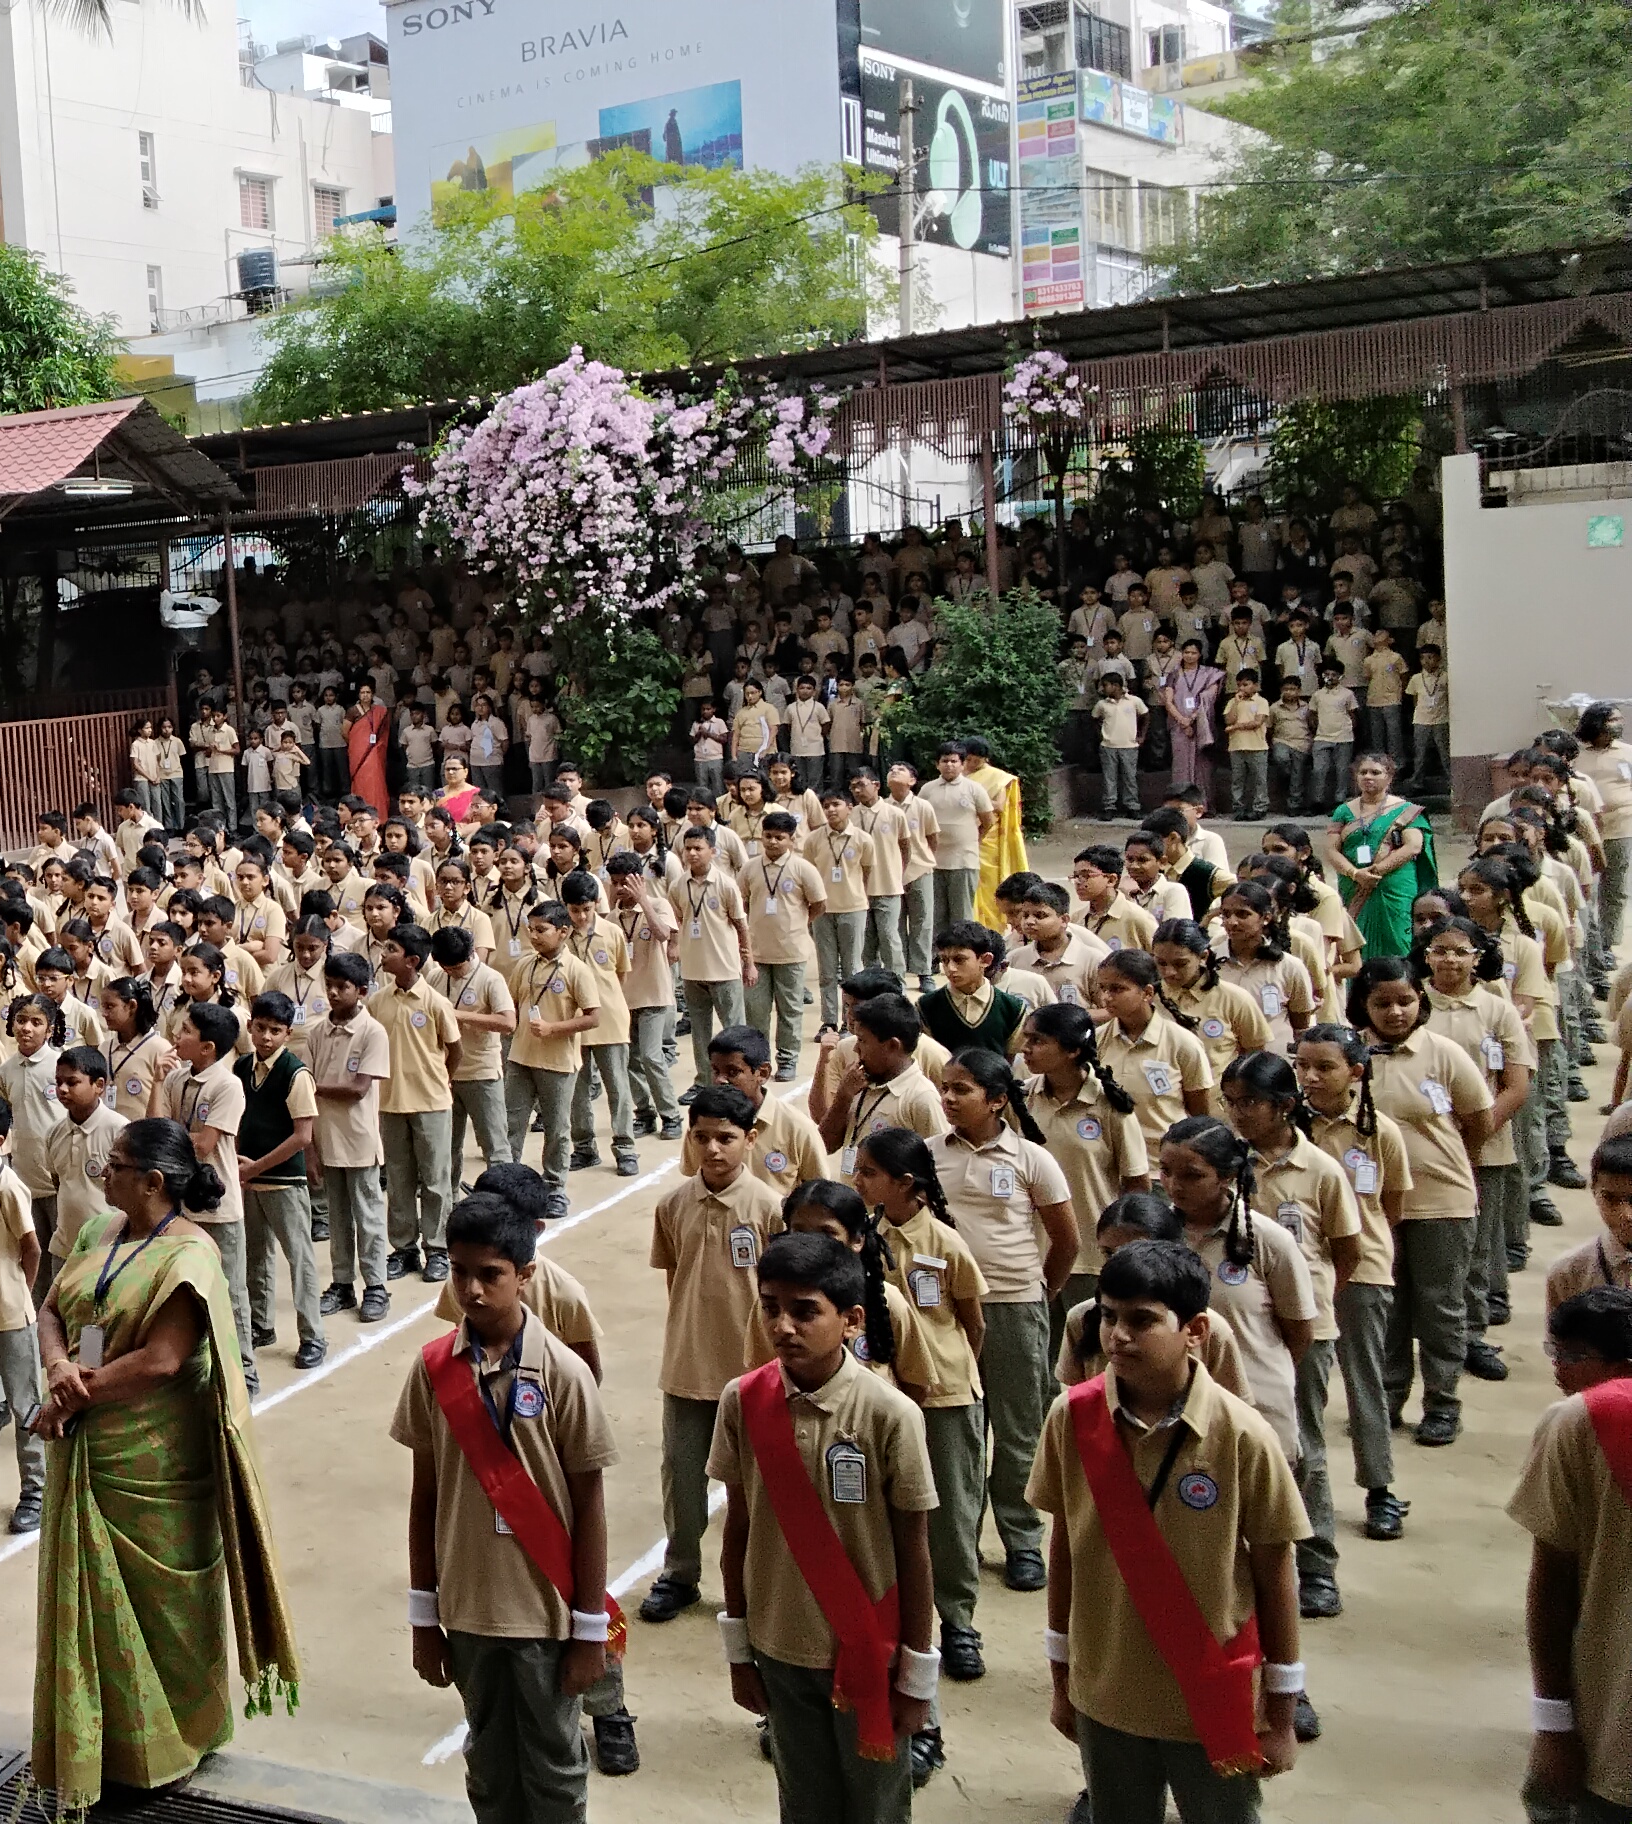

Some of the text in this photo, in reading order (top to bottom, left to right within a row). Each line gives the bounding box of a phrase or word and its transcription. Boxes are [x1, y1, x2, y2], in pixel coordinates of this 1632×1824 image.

[402, 0, 495, 37] SONY
[521, 19, 629, 63] BRAVIA
[457, 41, 704, 109] CINEMA IS COMING HOME
[864, 59, 896, 81] SONY
[866, 126, 896, 150] Massive
[989, 158, 1008, 188] ULT
